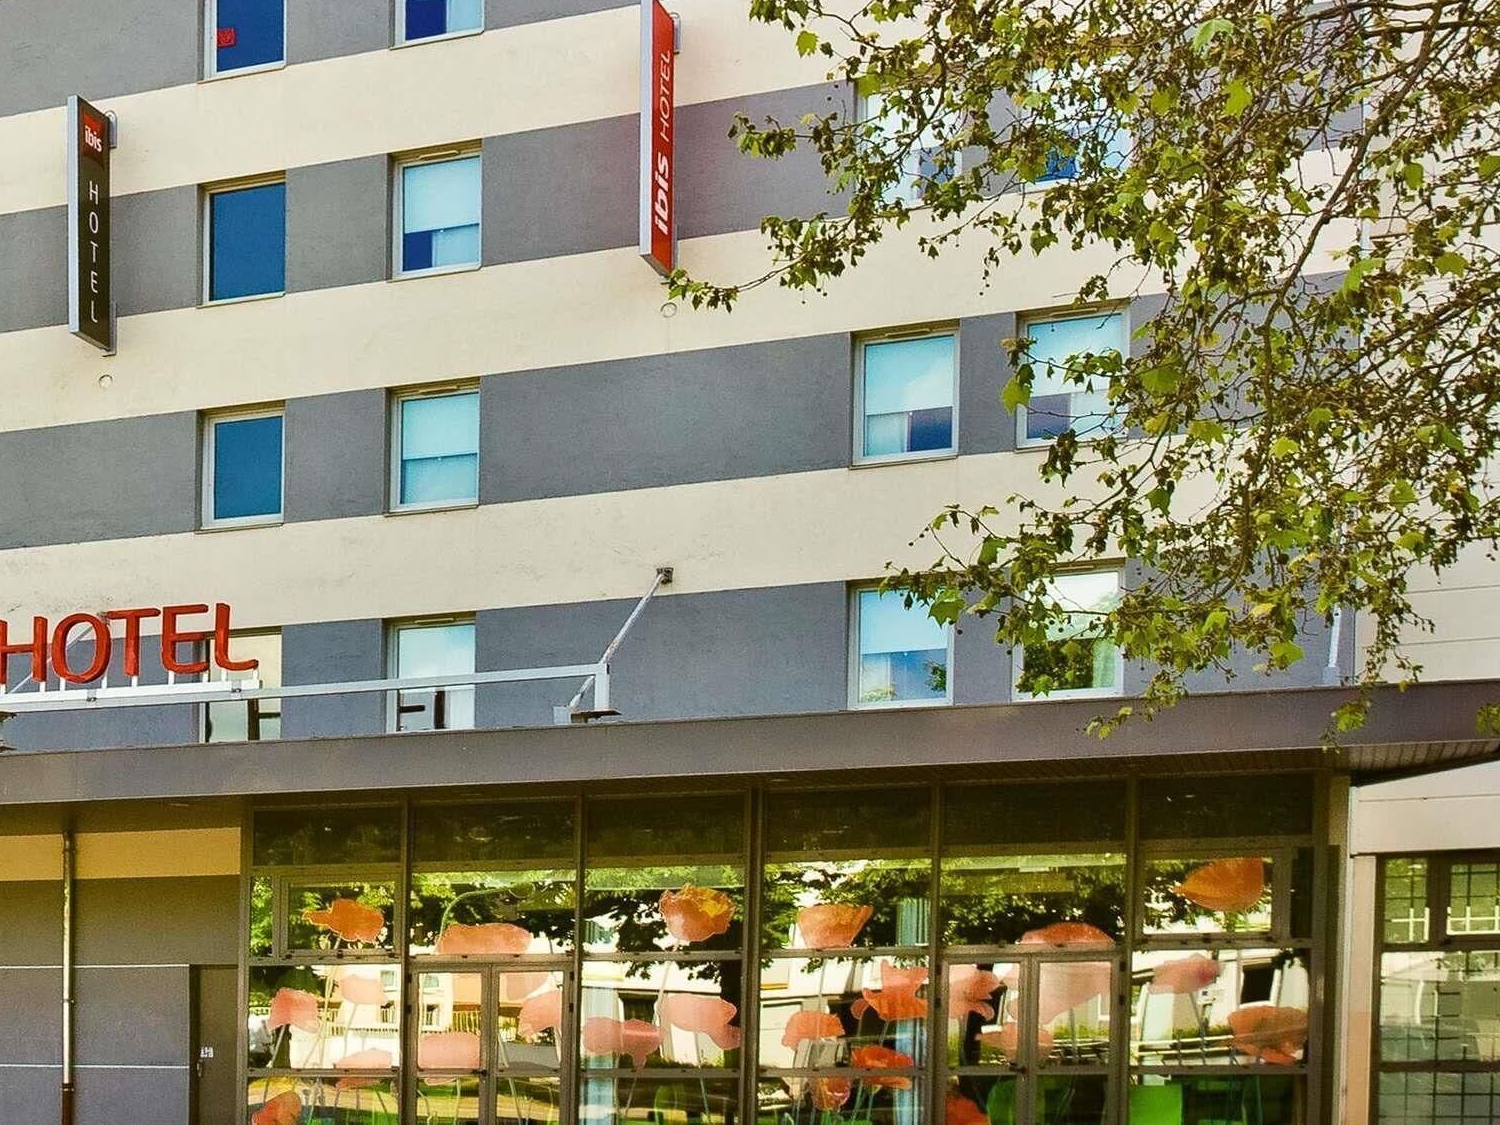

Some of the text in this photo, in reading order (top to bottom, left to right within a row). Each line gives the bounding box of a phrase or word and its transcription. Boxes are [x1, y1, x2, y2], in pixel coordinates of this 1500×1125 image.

[84, 125, 102, 153] ibis
[654, 49, 671, 236] ibis HOTEL
[88, 180, 99, 324] HOTEL
